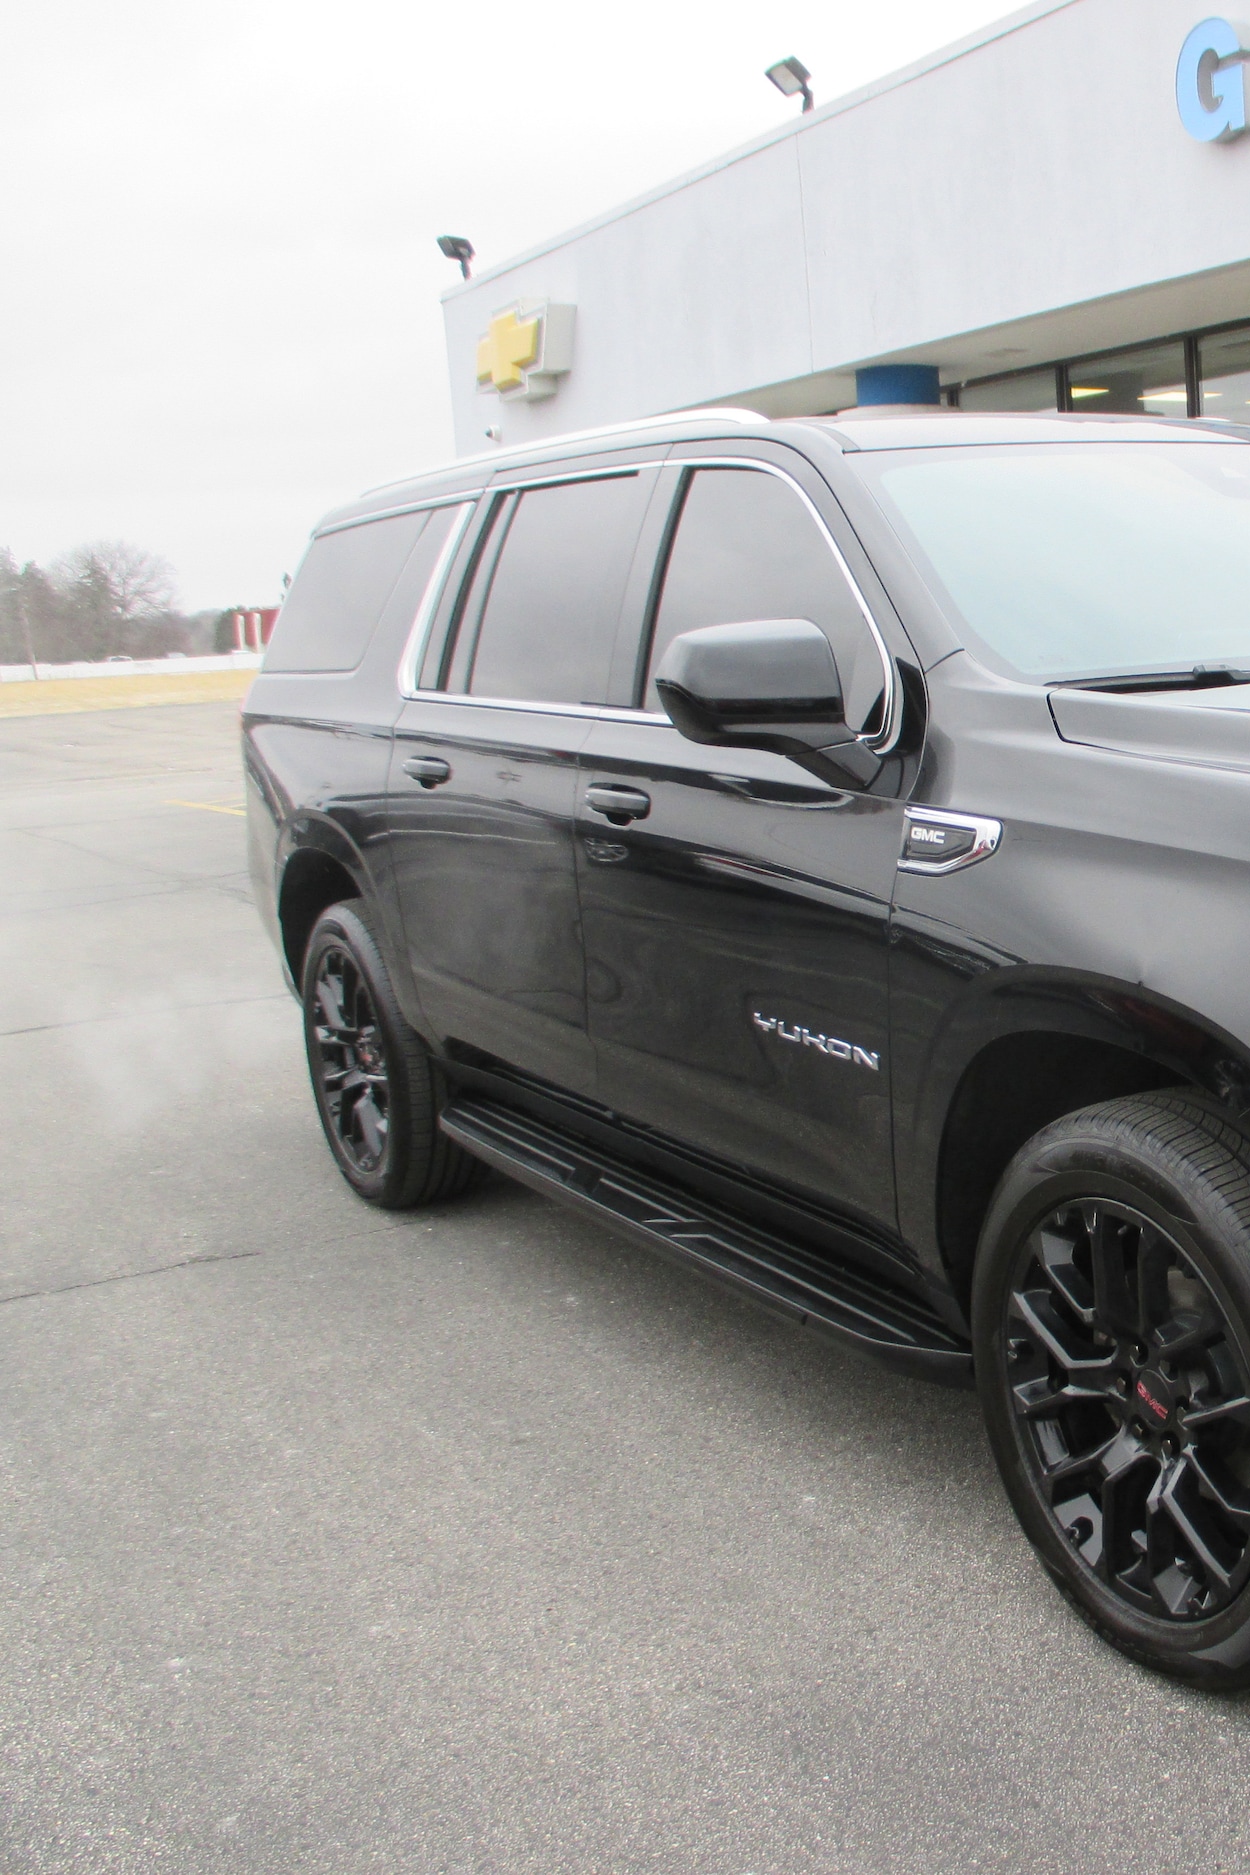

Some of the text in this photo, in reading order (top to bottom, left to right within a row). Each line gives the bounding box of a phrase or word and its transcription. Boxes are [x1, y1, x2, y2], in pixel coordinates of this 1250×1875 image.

[911, 826, 946, 844] GMC
[753, 1012, 880, 1071] YUKON
[1137, 1380, 1169, 1420] GMC
